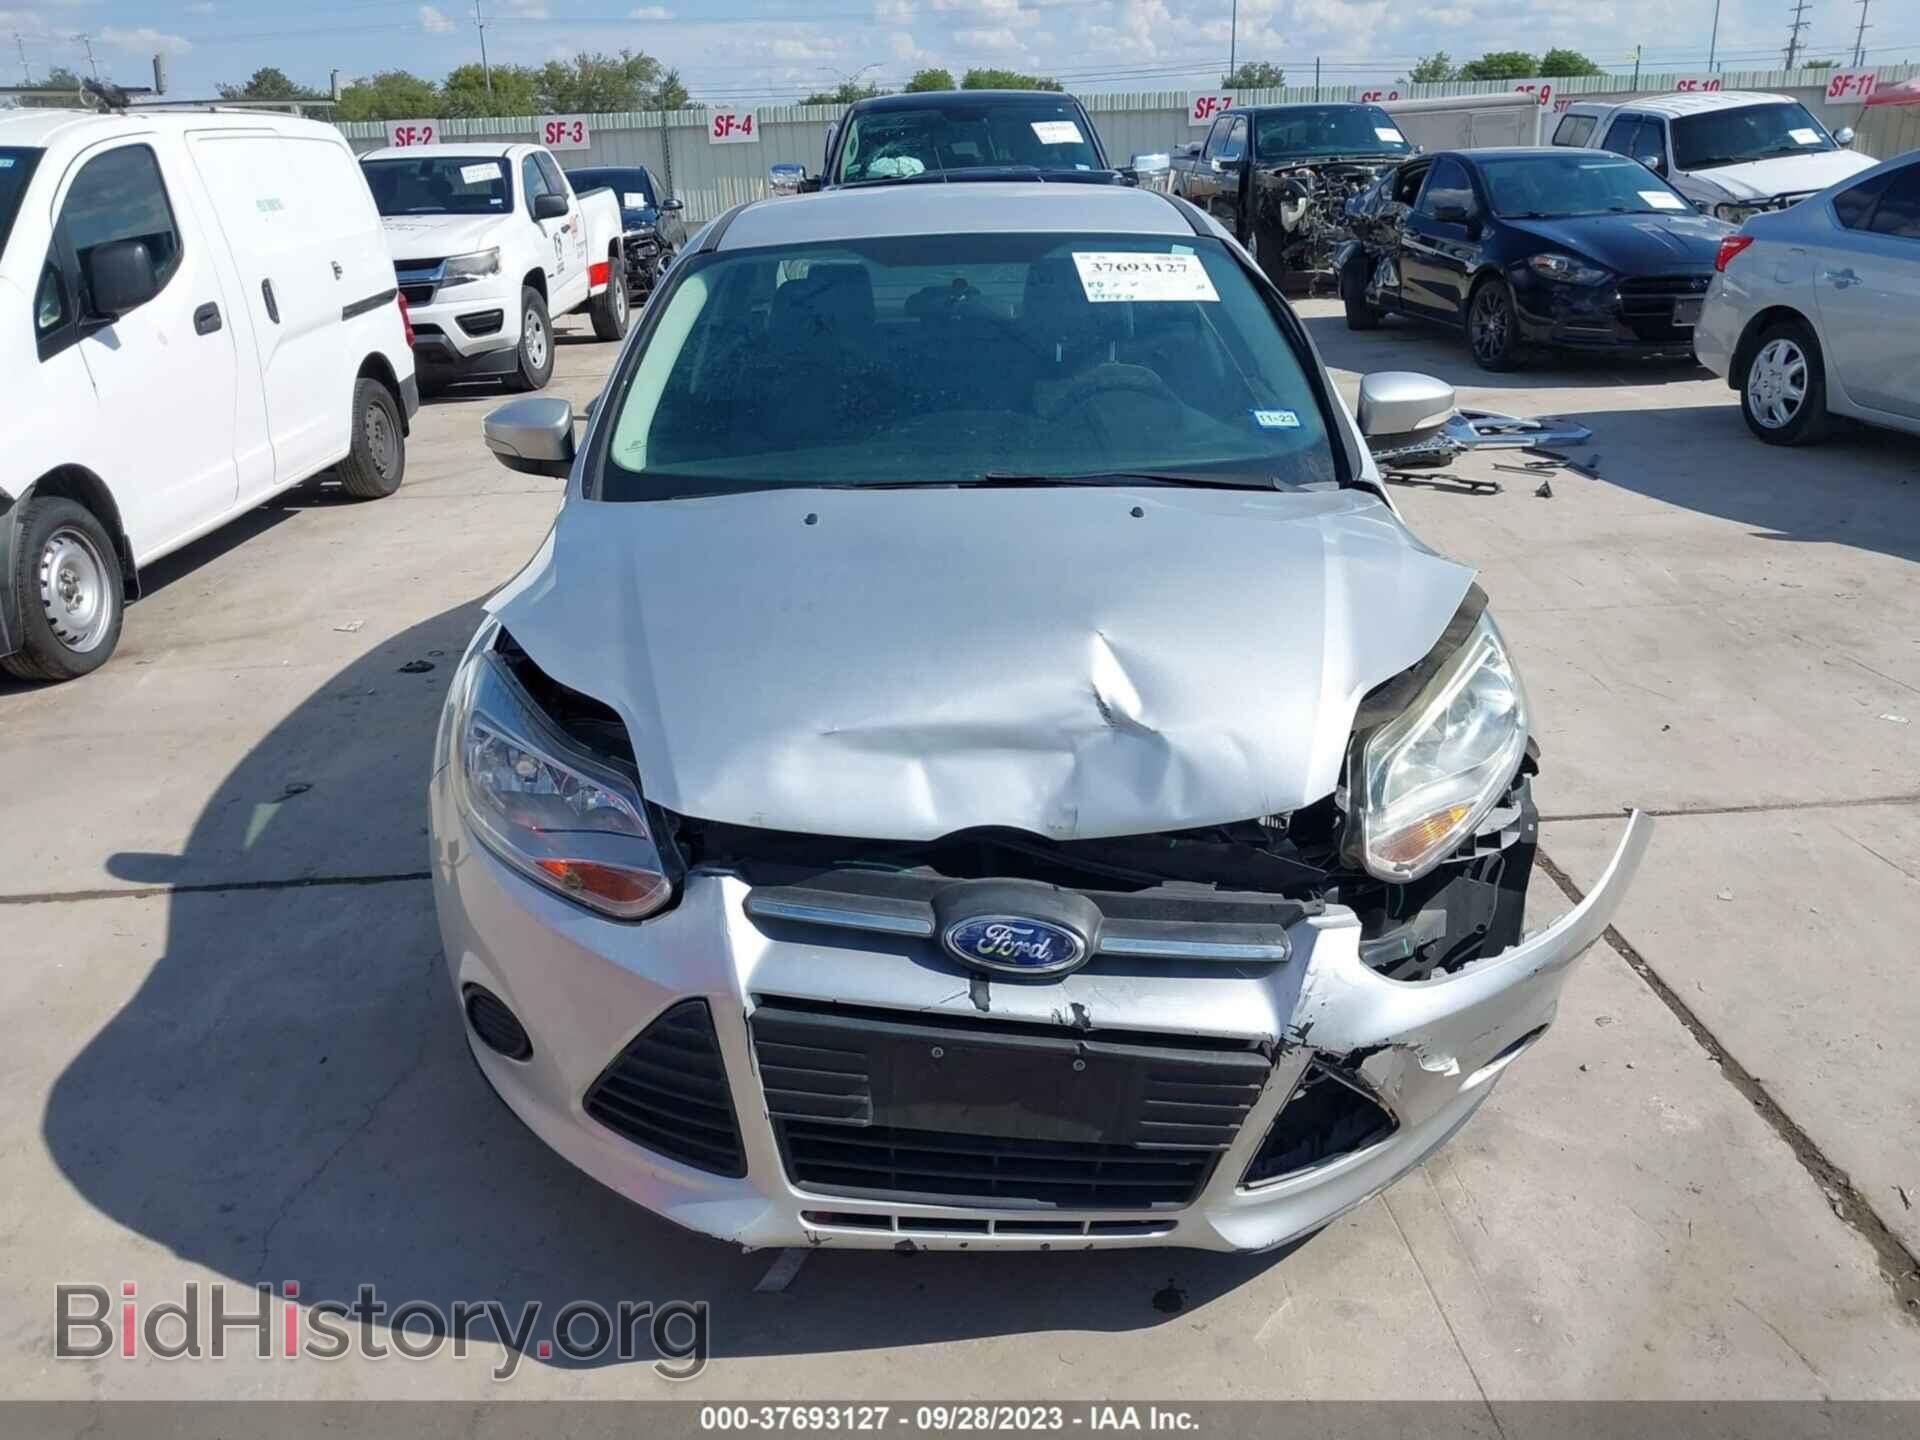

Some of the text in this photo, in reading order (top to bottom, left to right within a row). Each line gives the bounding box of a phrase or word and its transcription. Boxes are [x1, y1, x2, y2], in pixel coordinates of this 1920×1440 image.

[1829, 74, 1874, 97] SF-11
[1194, 96, 1232, 119] SF-7
[395, 126, 433, 147] SF-2
[546, 120, 583, 145] SF-3
[714, 114, 753, 137] SF-4
[1090, 262, 1188, 273] 37693127
[976, 923, 1051, 960] Ford
